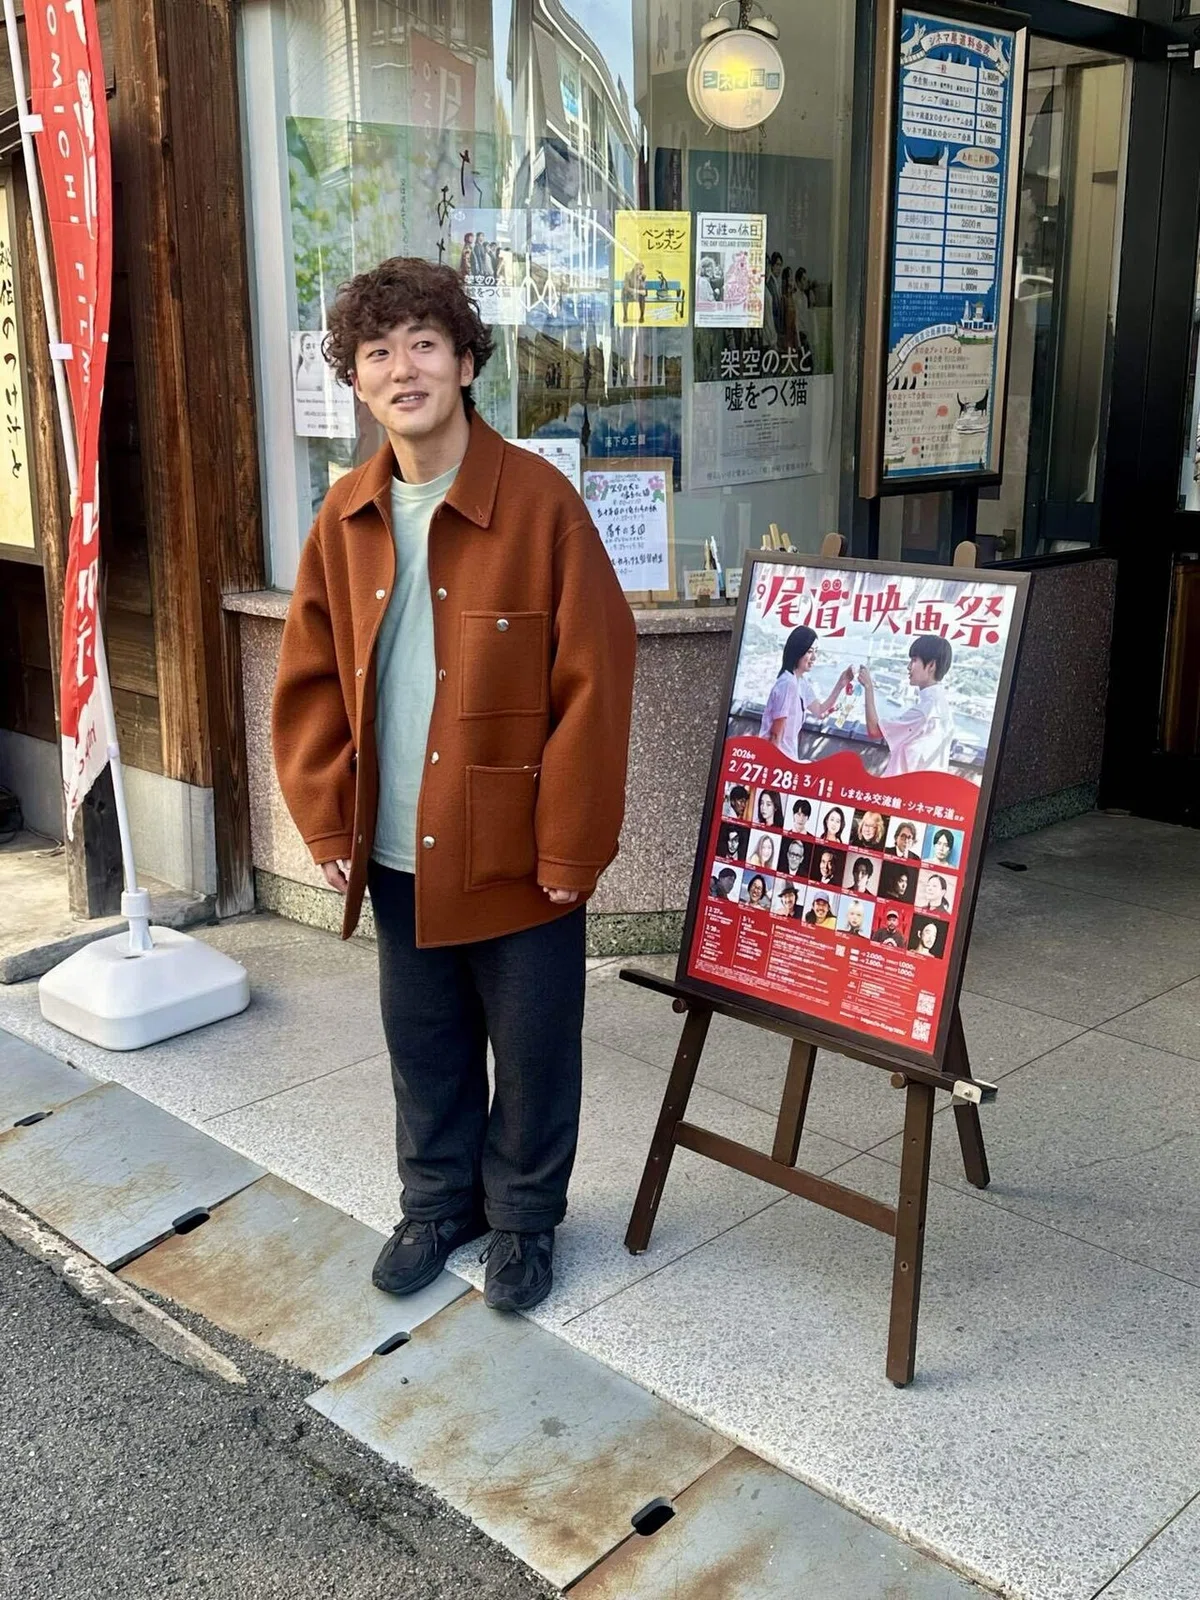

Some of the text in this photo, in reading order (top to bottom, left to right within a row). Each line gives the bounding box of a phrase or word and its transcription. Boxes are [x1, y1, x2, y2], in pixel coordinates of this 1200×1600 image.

[706, 222, 758, 236] 女性の休日
[721, 347, 812, 378] 架空の犬と
[725, 379, 808, 411] 嘘をつく猫
[762, 576, 1005, 648] 尾道映画祭
